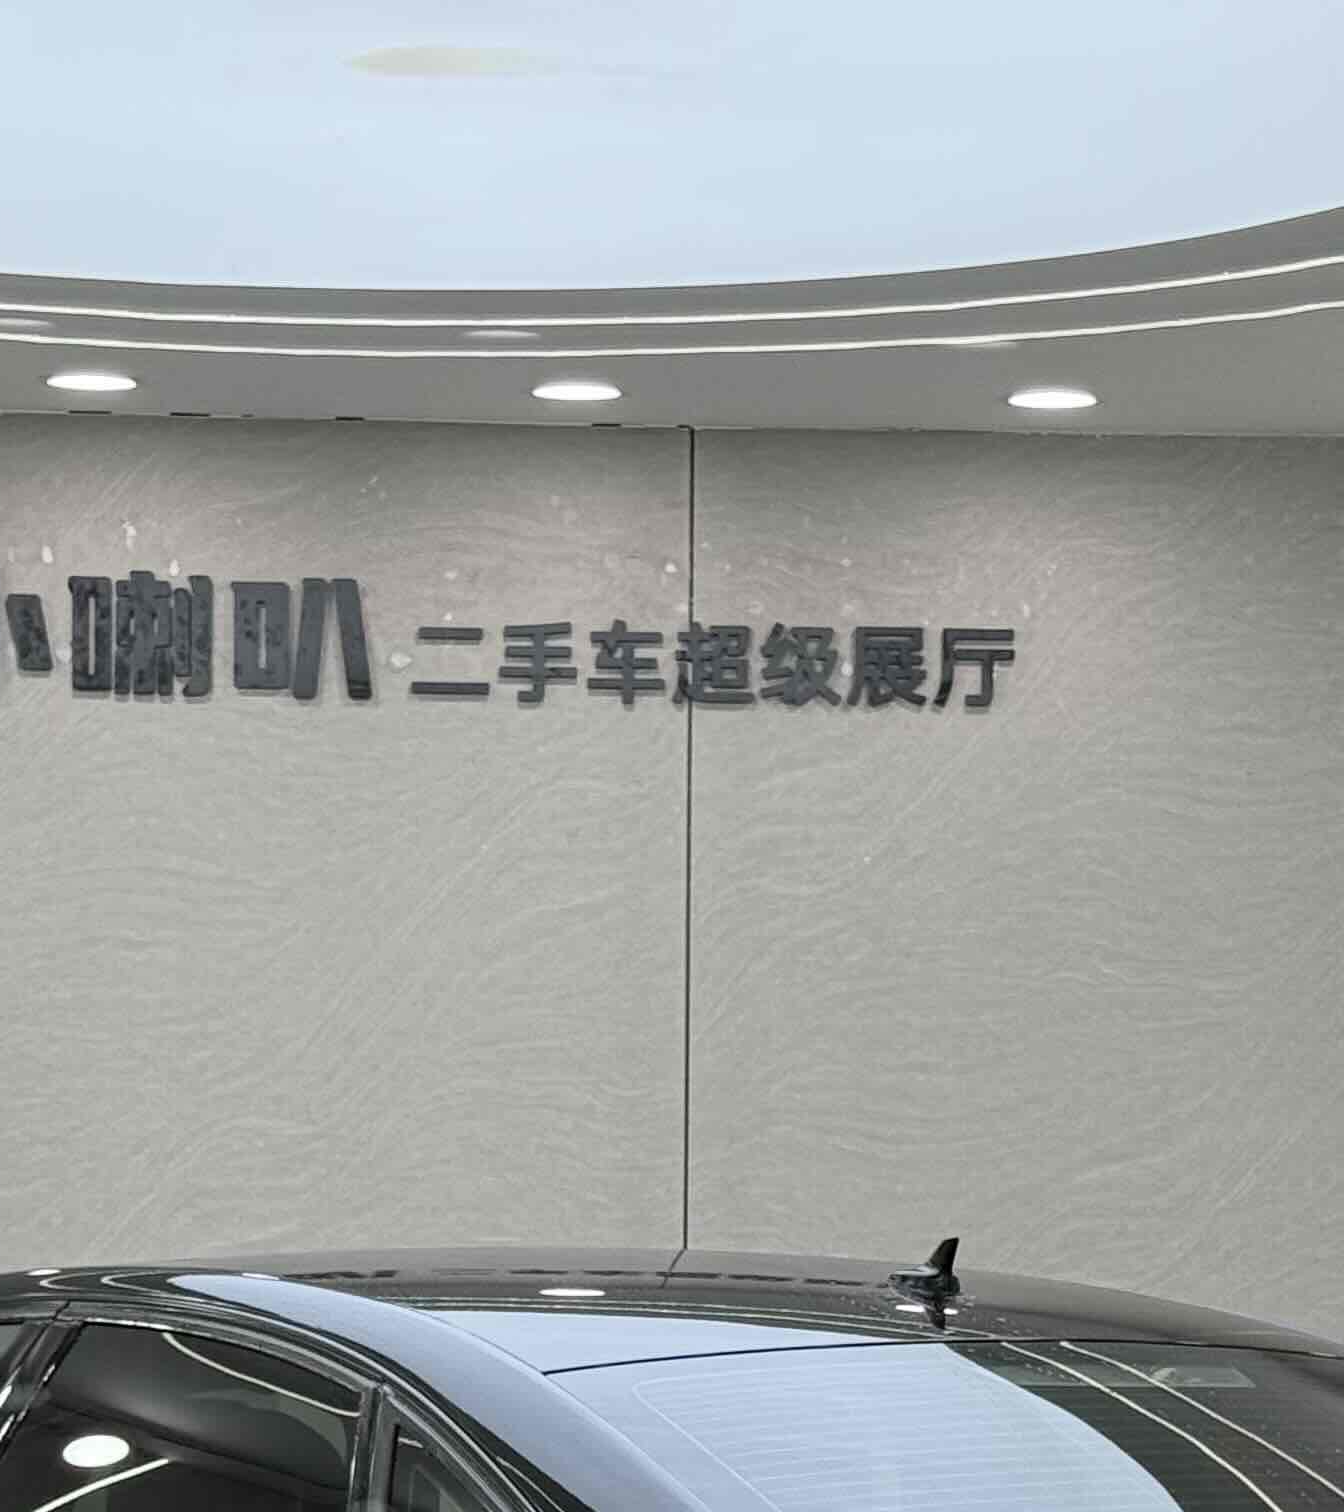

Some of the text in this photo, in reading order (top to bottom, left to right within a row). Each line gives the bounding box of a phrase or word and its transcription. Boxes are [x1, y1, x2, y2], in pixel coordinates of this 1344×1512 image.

[411, 619, 1016, 709] 二手车超级展厅
